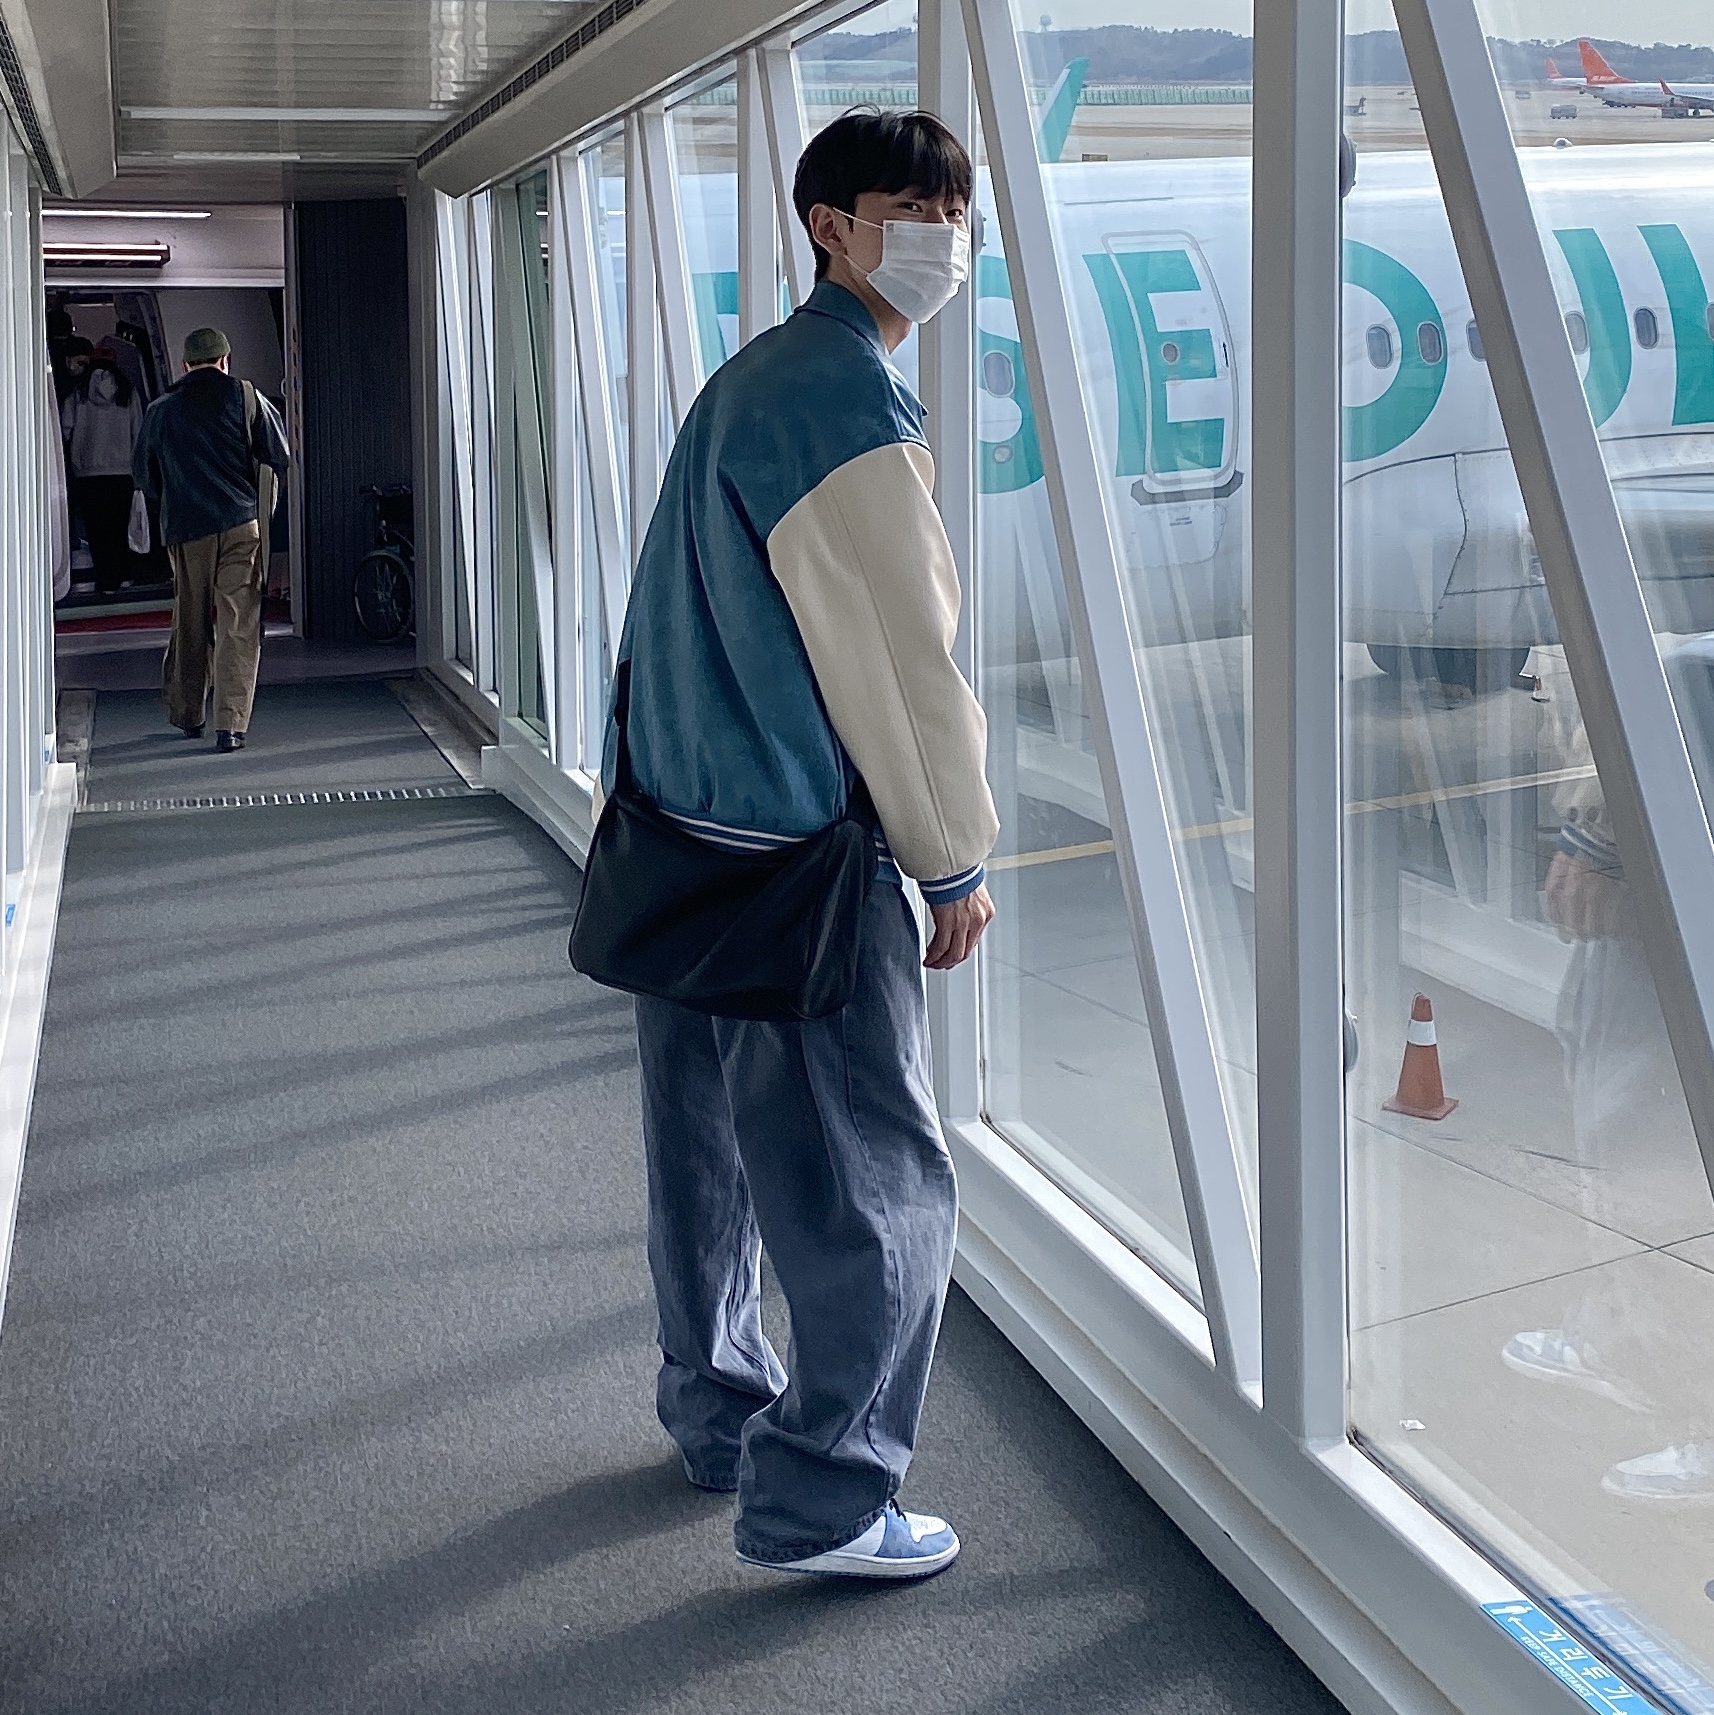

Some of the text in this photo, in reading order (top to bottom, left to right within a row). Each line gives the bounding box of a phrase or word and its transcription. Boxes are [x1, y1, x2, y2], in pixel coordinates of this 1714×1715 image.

[1520, 1636, 1595, 1698] KEEP SAFE DISTANCE
[1538, 1629, 1634, 1700] 거리두기
